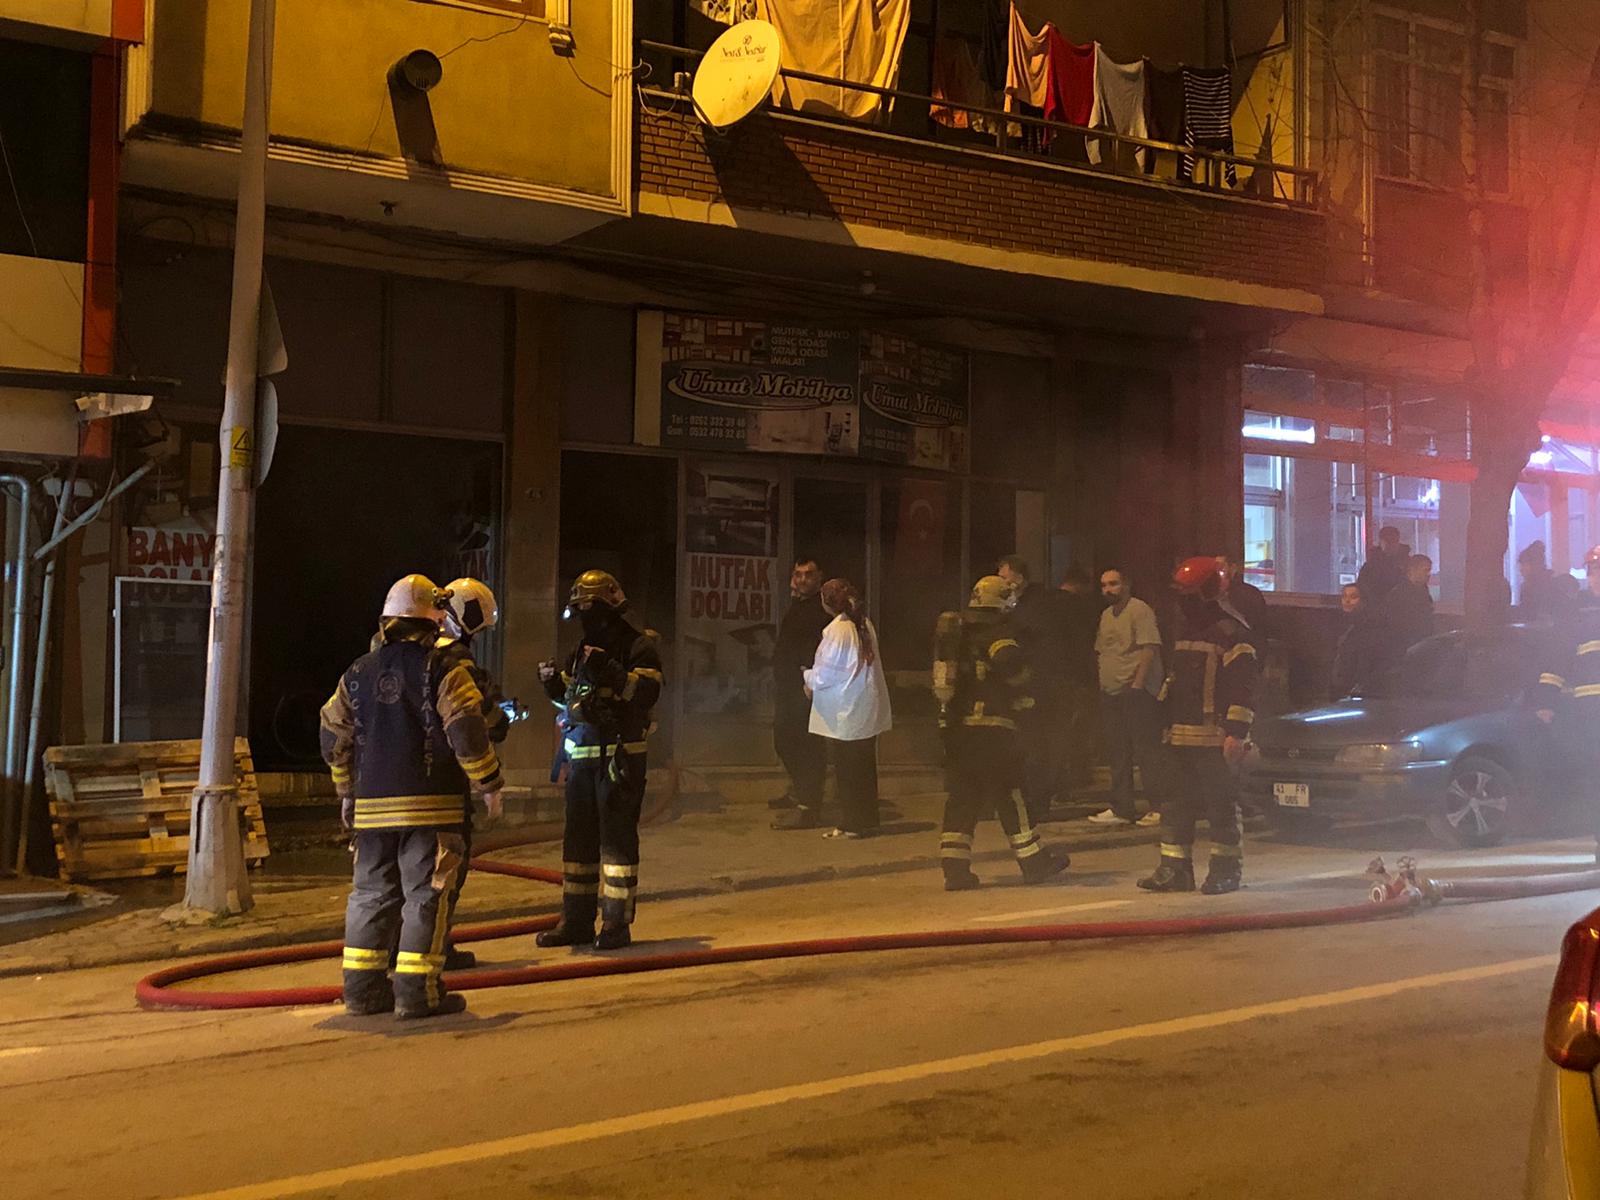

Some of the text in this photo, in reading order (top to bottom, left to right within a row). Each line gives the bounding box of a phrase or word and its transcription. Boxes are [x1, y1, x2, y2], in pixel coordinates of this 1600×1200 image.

[680, 368, 853, 404] Umut Mobilya
[871, 383, 963, 421] Umut Mobilya
[127, 530, 216, 567] BANY
[690, 555, 769, 590] MUTFAK
[690, 590, 772, 621] DOLABI
